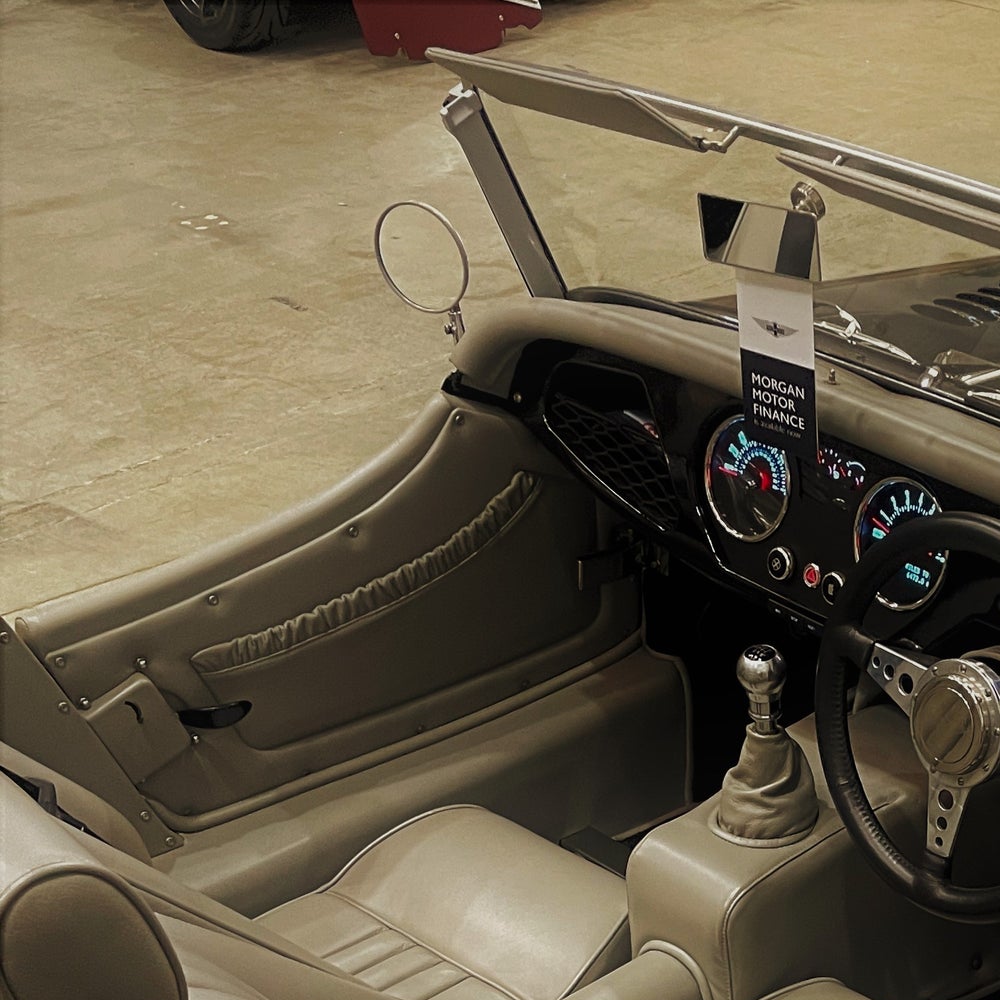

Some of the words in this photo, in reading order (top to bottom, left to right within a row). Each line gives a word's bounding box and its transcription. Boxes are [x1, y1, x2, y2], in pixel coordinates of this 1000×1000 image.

[751, 372, 805, 400] MORGAN
[752, 387, 796, 413] MOTOR
[753, 402, 805, 430] FINANCE
